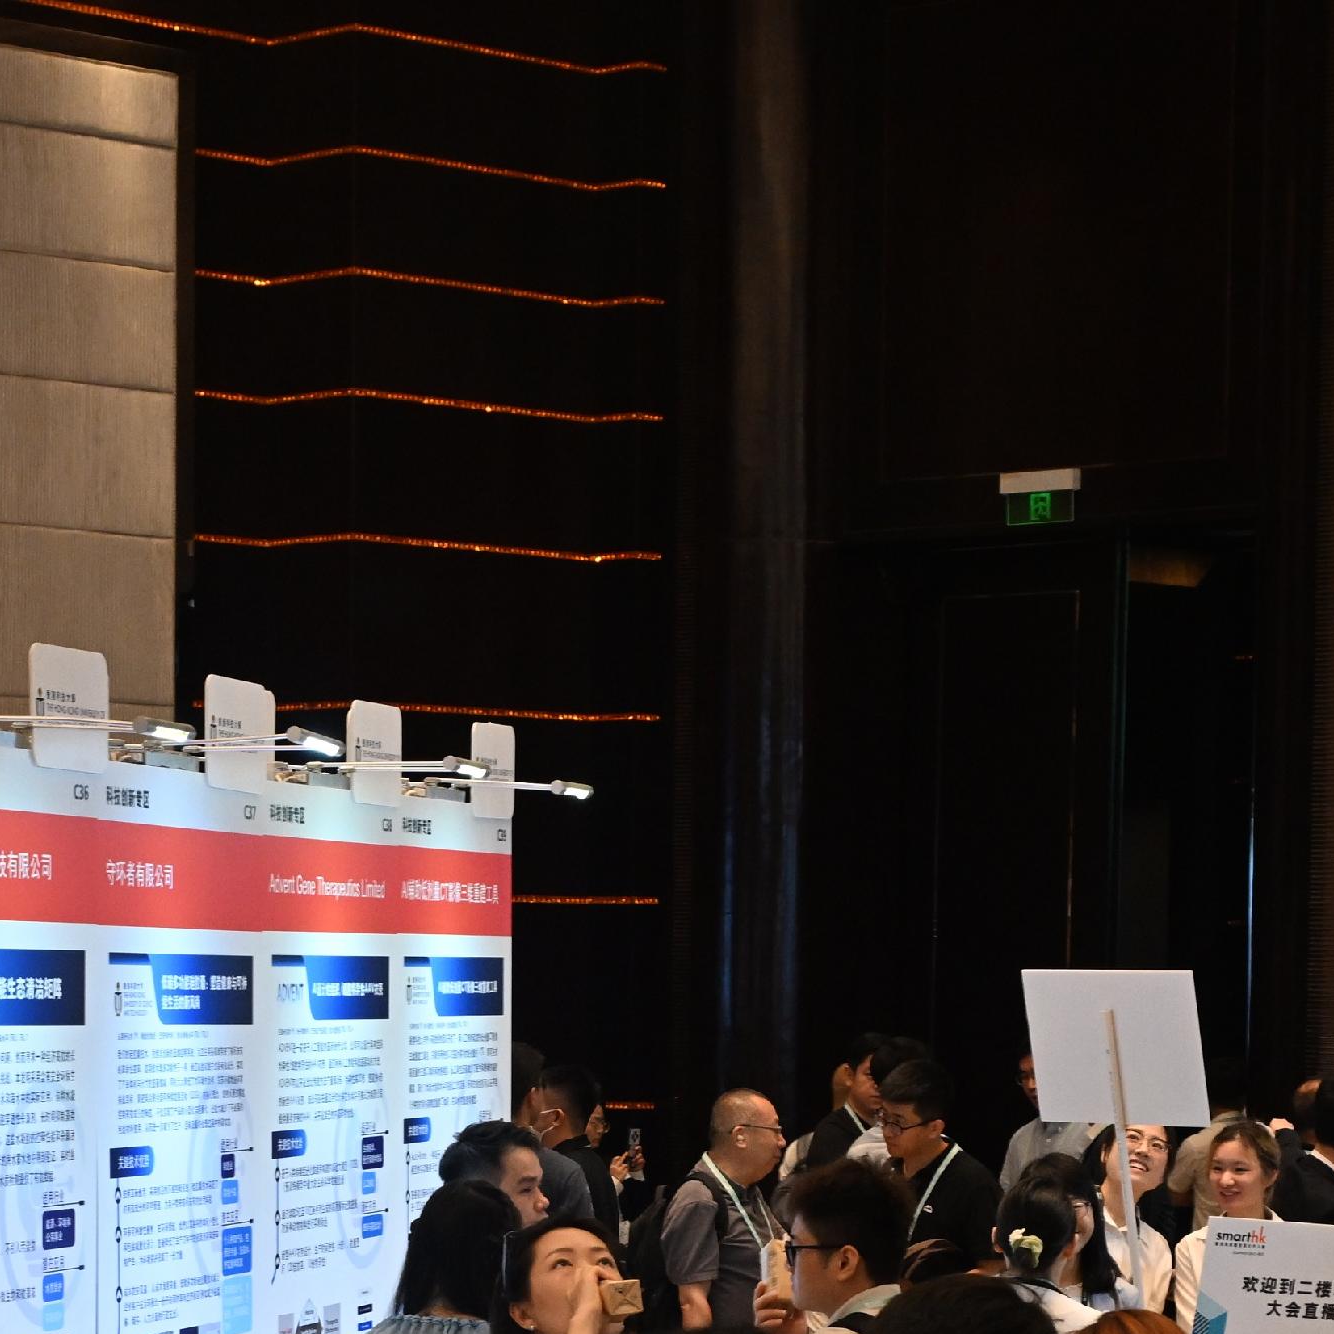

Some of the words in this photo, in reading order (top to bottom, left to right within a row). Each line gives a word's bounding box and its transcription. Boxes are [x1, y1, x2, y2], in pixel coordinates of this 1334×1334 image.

[73, 783, 90, 800] C36
[270, 873, 296, 893] Advent
[296, 876, 315, 896] Gene
[361, 878, 386, 899] Limited
[1216, 1226, 1267, 1244] smarthk
